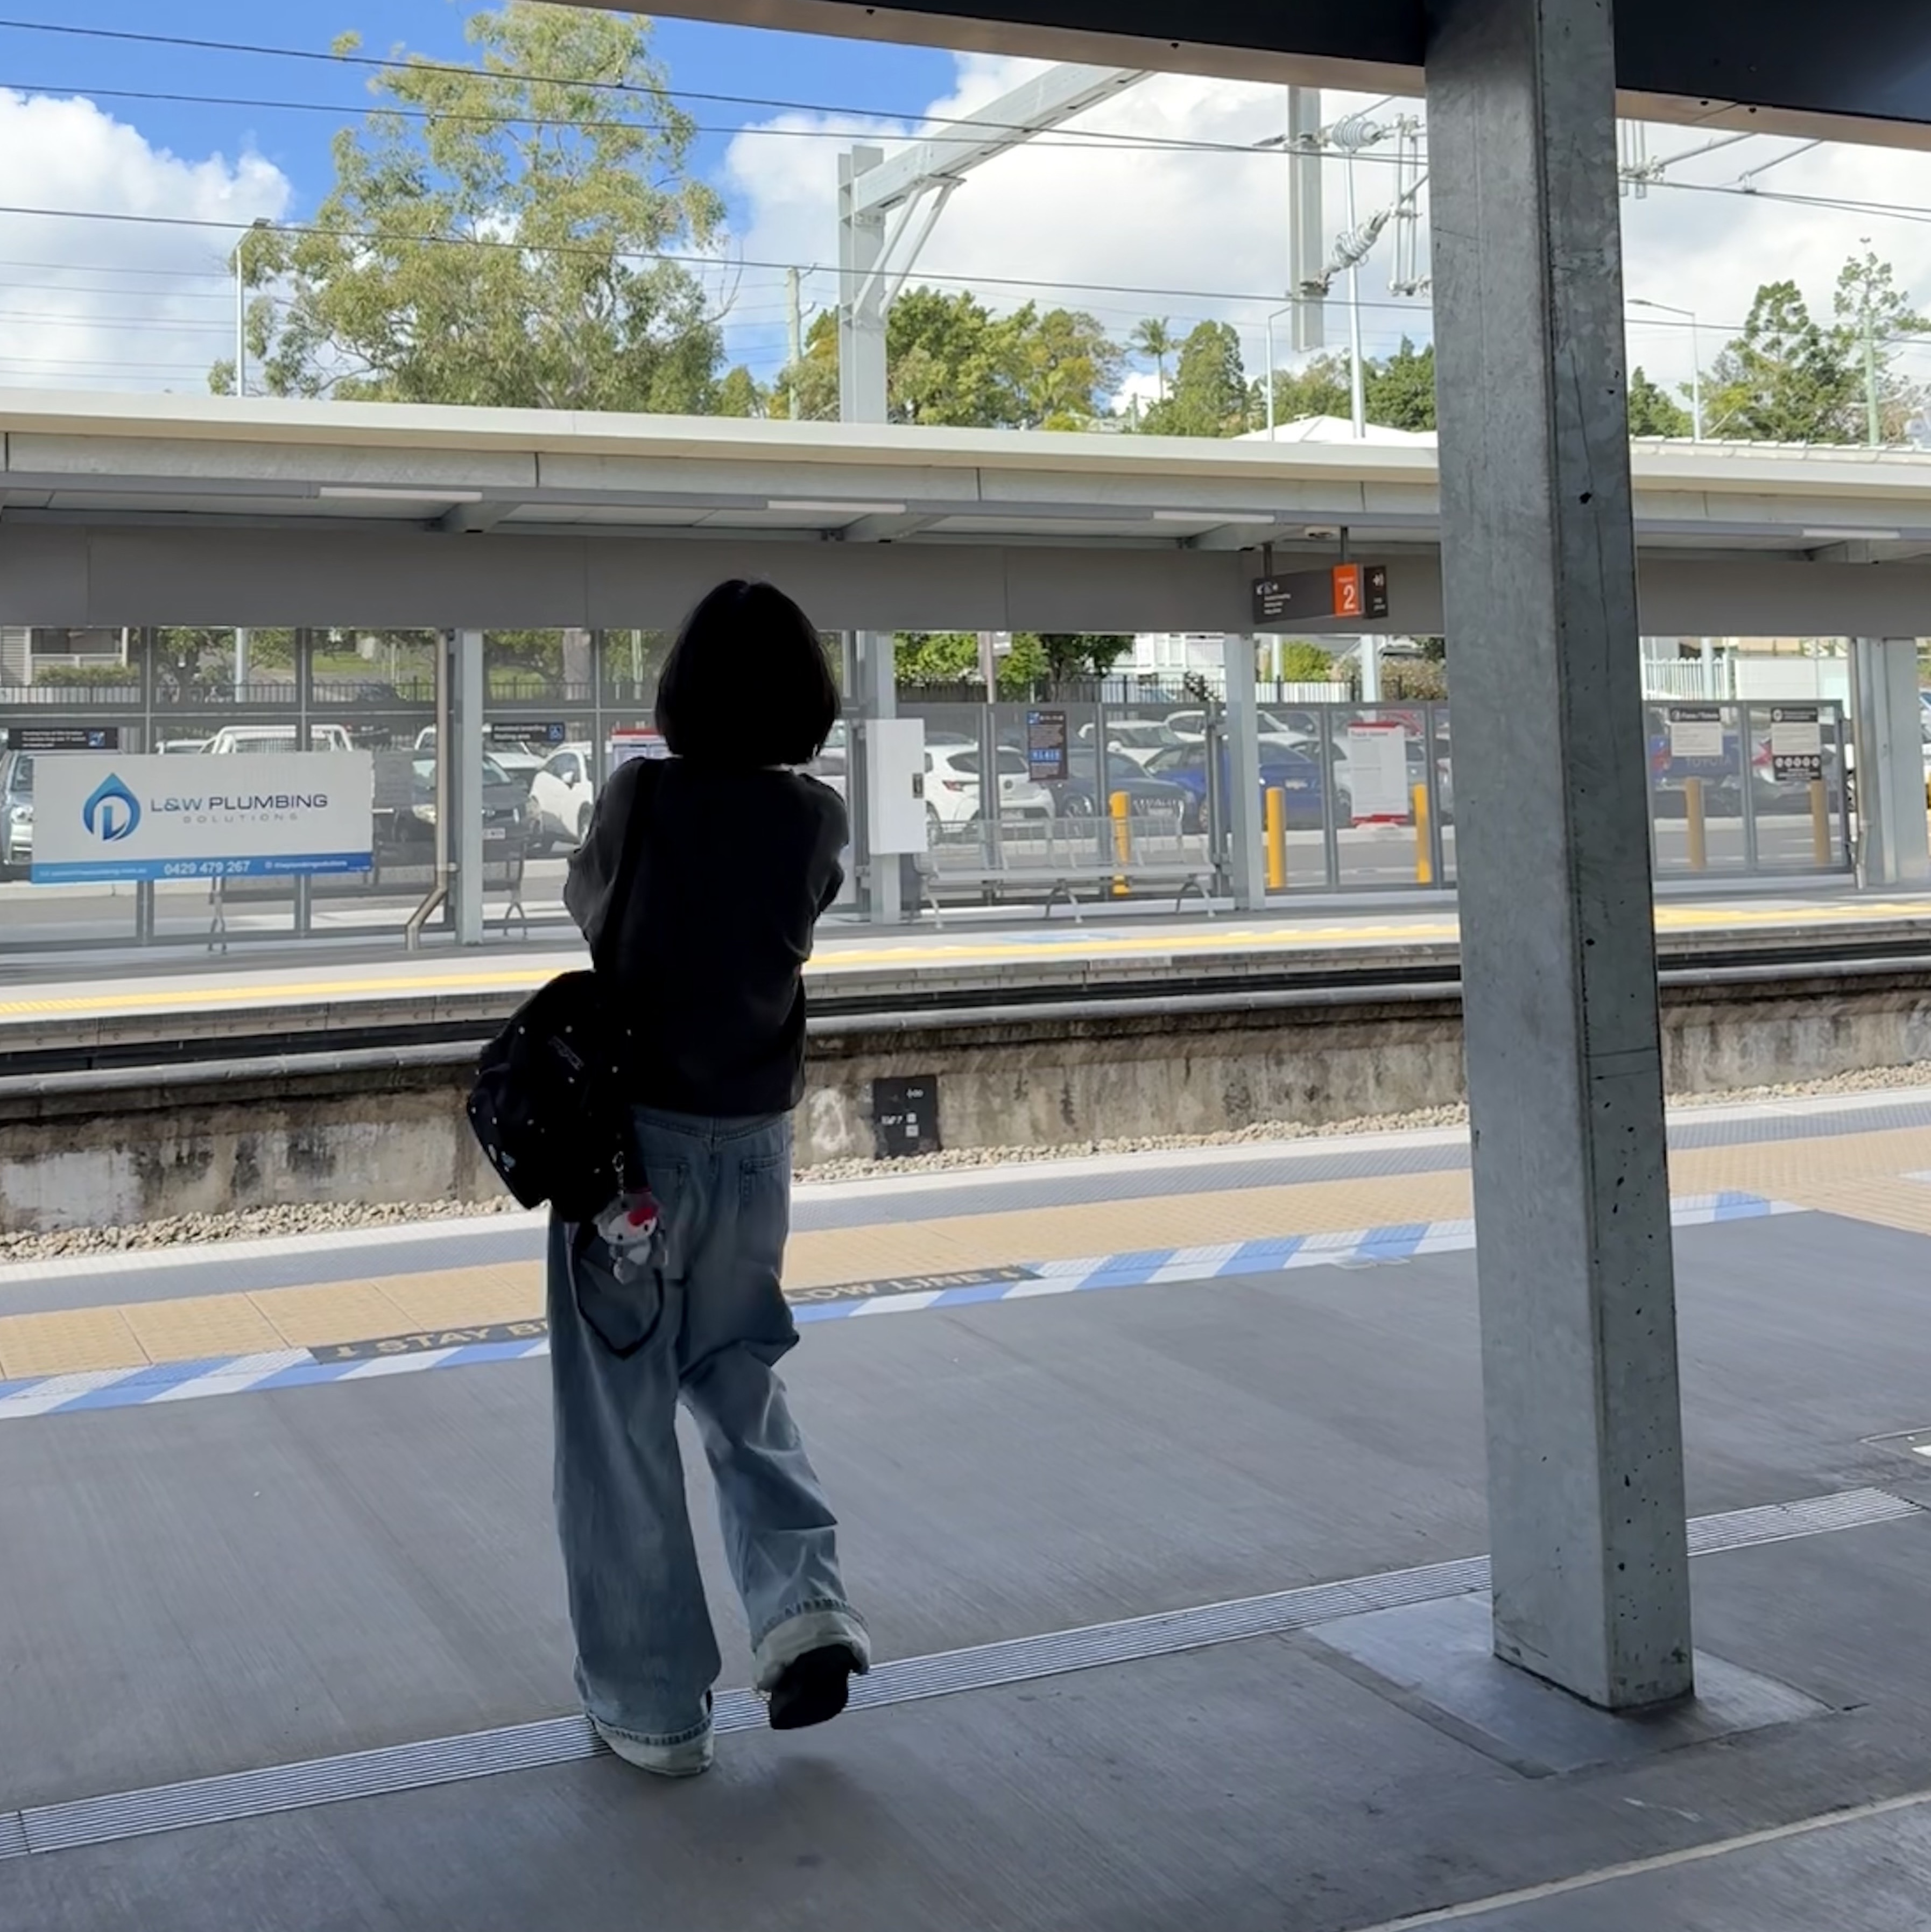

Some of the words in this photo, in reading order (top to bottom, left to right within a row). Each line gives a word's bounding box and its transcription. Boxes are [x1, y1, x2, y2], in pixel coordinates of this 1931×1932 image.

[1343, 584, 1355, 609] 2
[151, 798, 202, 812] L&W
[208, 794, 328, 810] PLUMBING
[183, 812, 298, 824] SOLUTIONS
[164, 862, 196, 875] 0429
[199, 861, 224, 874] 479
[227, 860, 251, 872] 267
[890, 1271, 989, 1290] LINE
[376, 1329, 489, 1353] STAY
